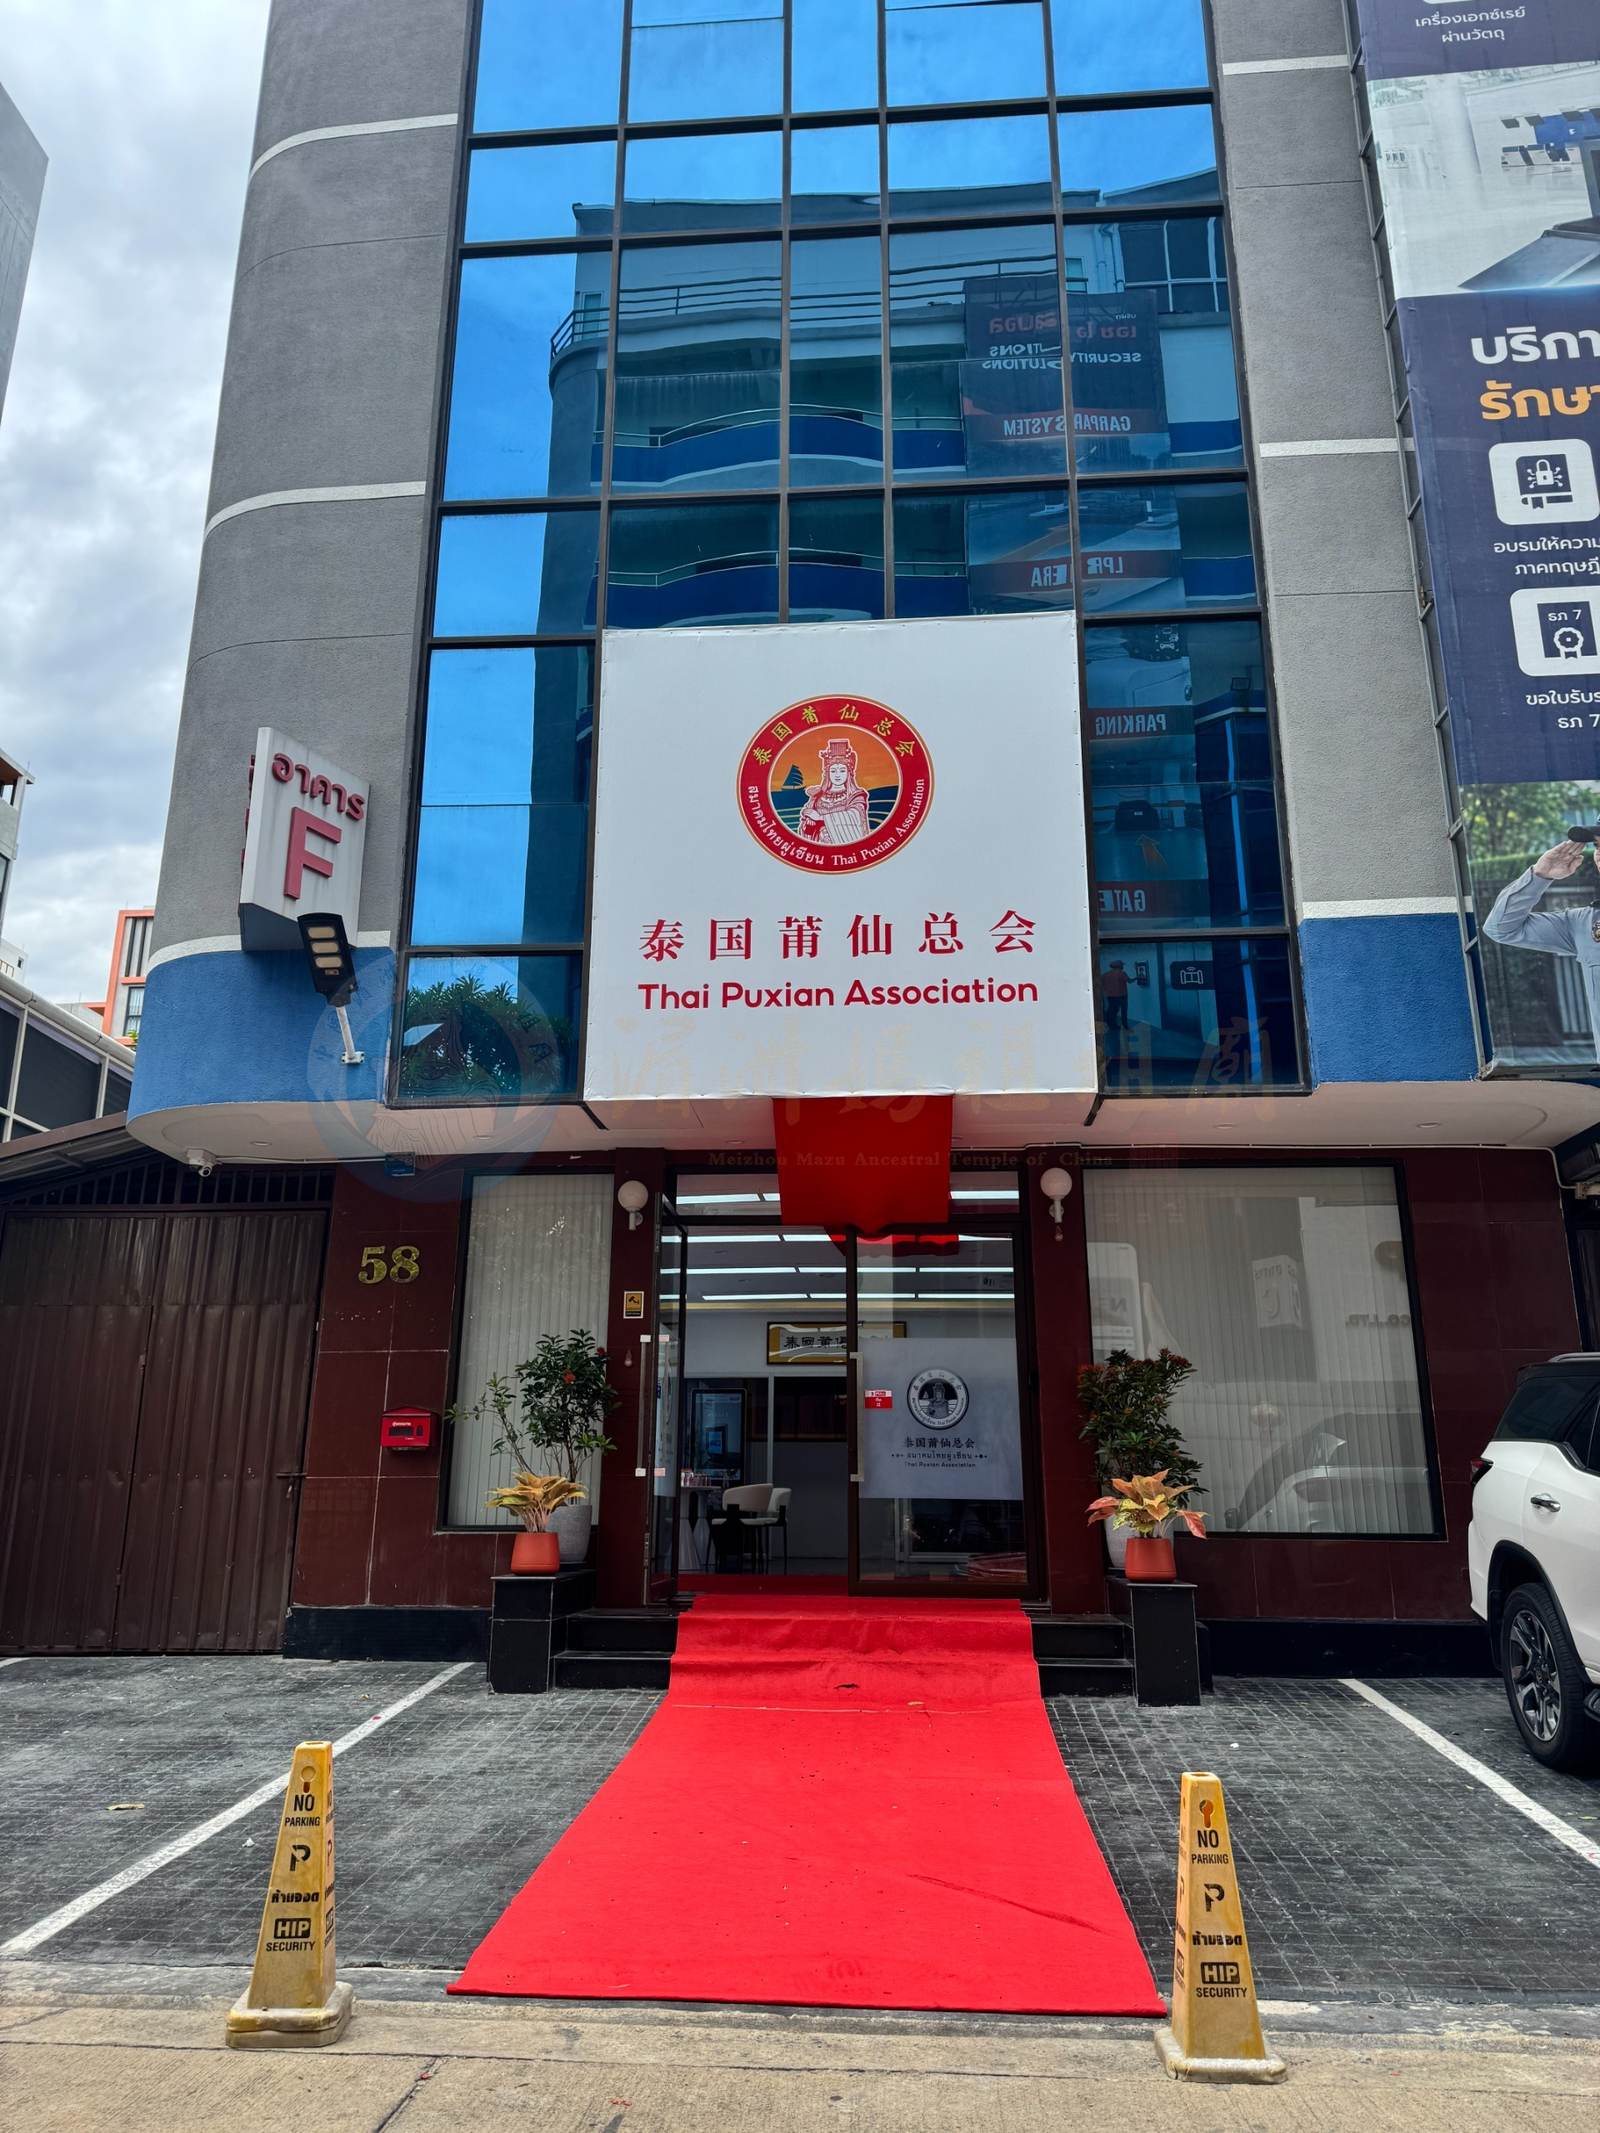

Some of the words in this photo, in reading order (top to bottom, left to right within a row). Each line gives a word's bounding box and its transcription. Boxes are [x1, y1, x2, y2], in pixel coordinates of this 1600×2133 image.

[1415, 6, 1526, 27] เครื่องเอกซ์เรย์
[1441, 28, 1506, 43] ผ่านวัตถุ
[1572, 609, 1582, 620] 7
[753, 704, 916, 766] 泰国莆仙总会
[272, 752, 365, 821] อาคาร
[831, 852, 858, 866] Thai
[861, 837, 896, 861] Puxian
[895, 778, 926, 838] Association
[284, 806, 342, 900] F
[638, 909, 1037, 963] 泰国莆仙总会
[638, 983, 710, 1010] Thai
[721, 981, 834, 1009] Puxian
[844, 976, 1039, 1007] Association
[357, 1245, 421, 1285] 58
[293, 1794, 315, 1812] NO
[284, 1816, 321, 1827] PARKING
[1197, 1829, 1220, 1849] NO
[1191, 1853, 1229, 1865] PARKING
[276, 1920, 310, 1937] HIP
[265, 1941, 316, 1952] SECURITY
[1203, 1964, 1239, 1983] HIP
[1195, 1986, 1248, 1999] SECURITY
